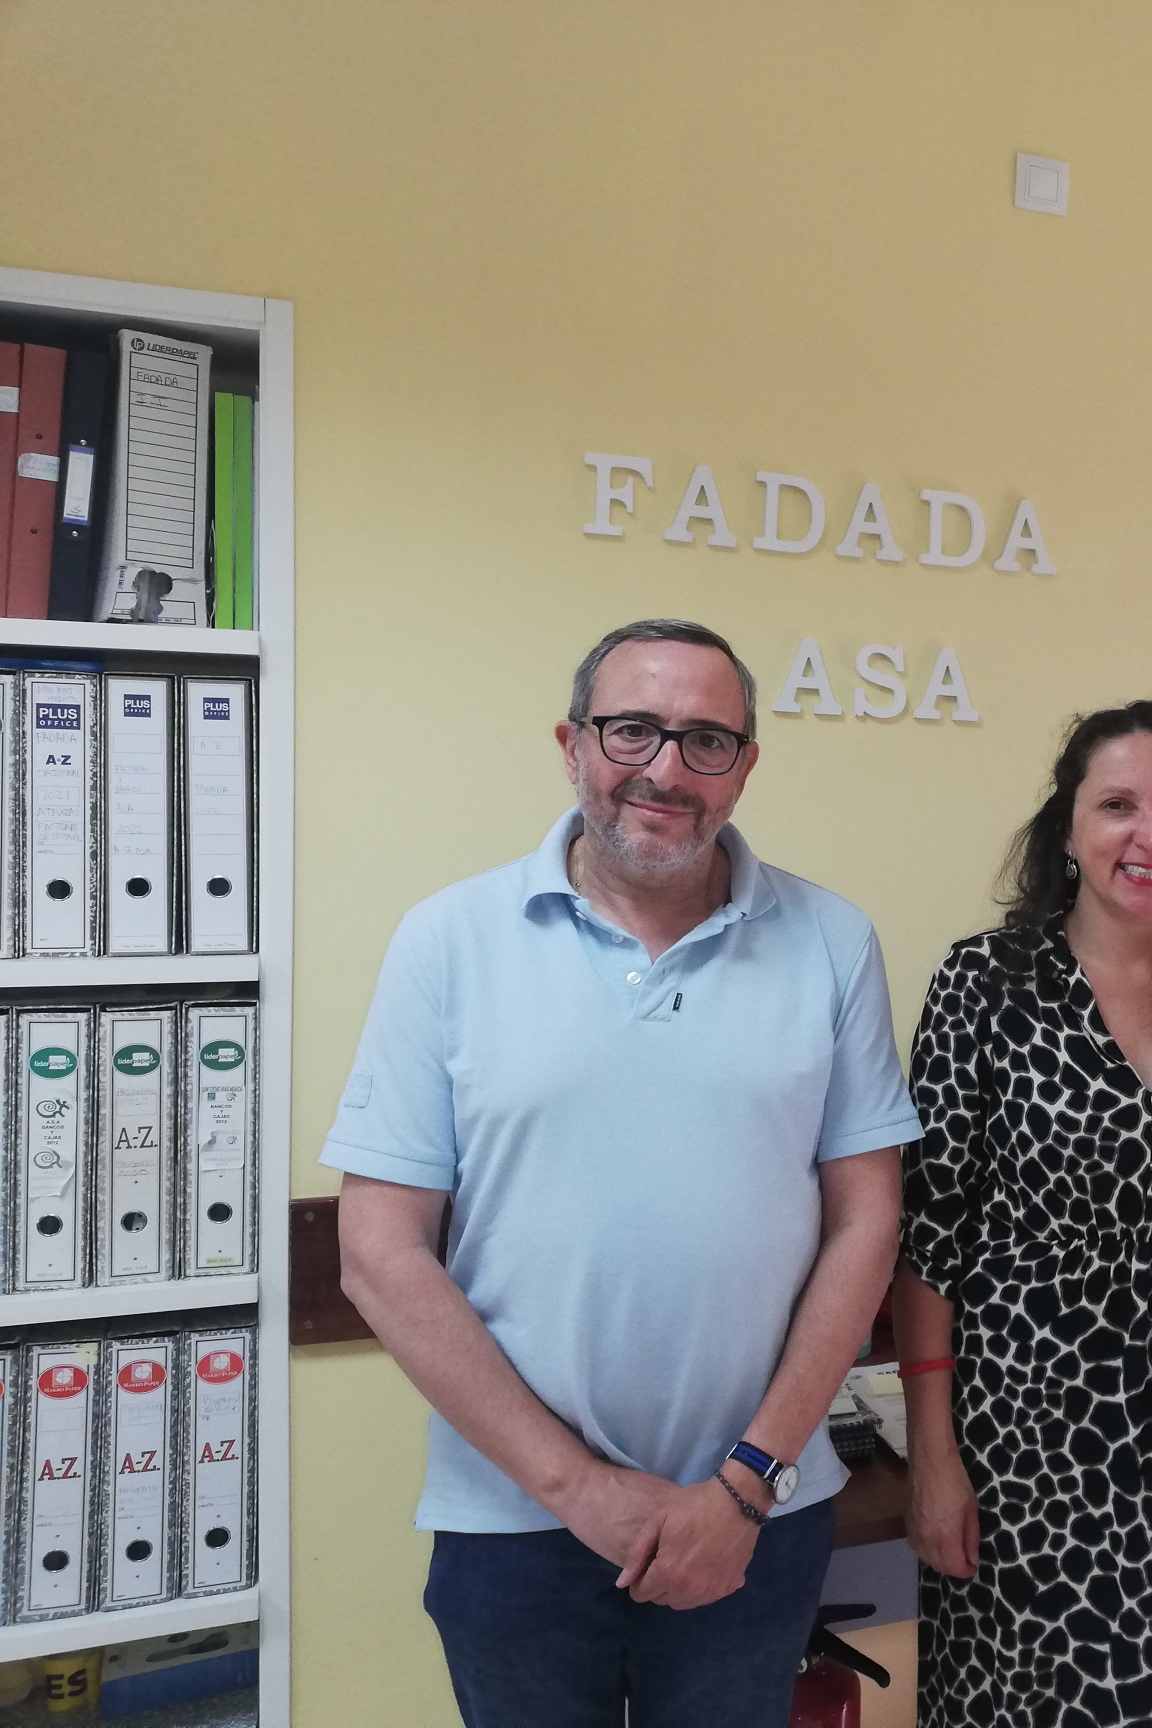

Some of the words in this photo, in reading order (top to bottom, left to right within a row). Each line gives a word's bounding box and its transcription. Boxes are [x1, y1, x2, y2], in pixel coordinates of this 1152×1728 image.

[136, 371, 178, 388] FADADA
[583, 451, 1057, 576] FADADA
[773, 636, 979, 723] ASA
[125, 699, 150, 708] PLUS
[204, 702, 229, 711] PLUS
[39, 707, 78, 719] PLUS
[45, 1668, 88, 1701] ES
